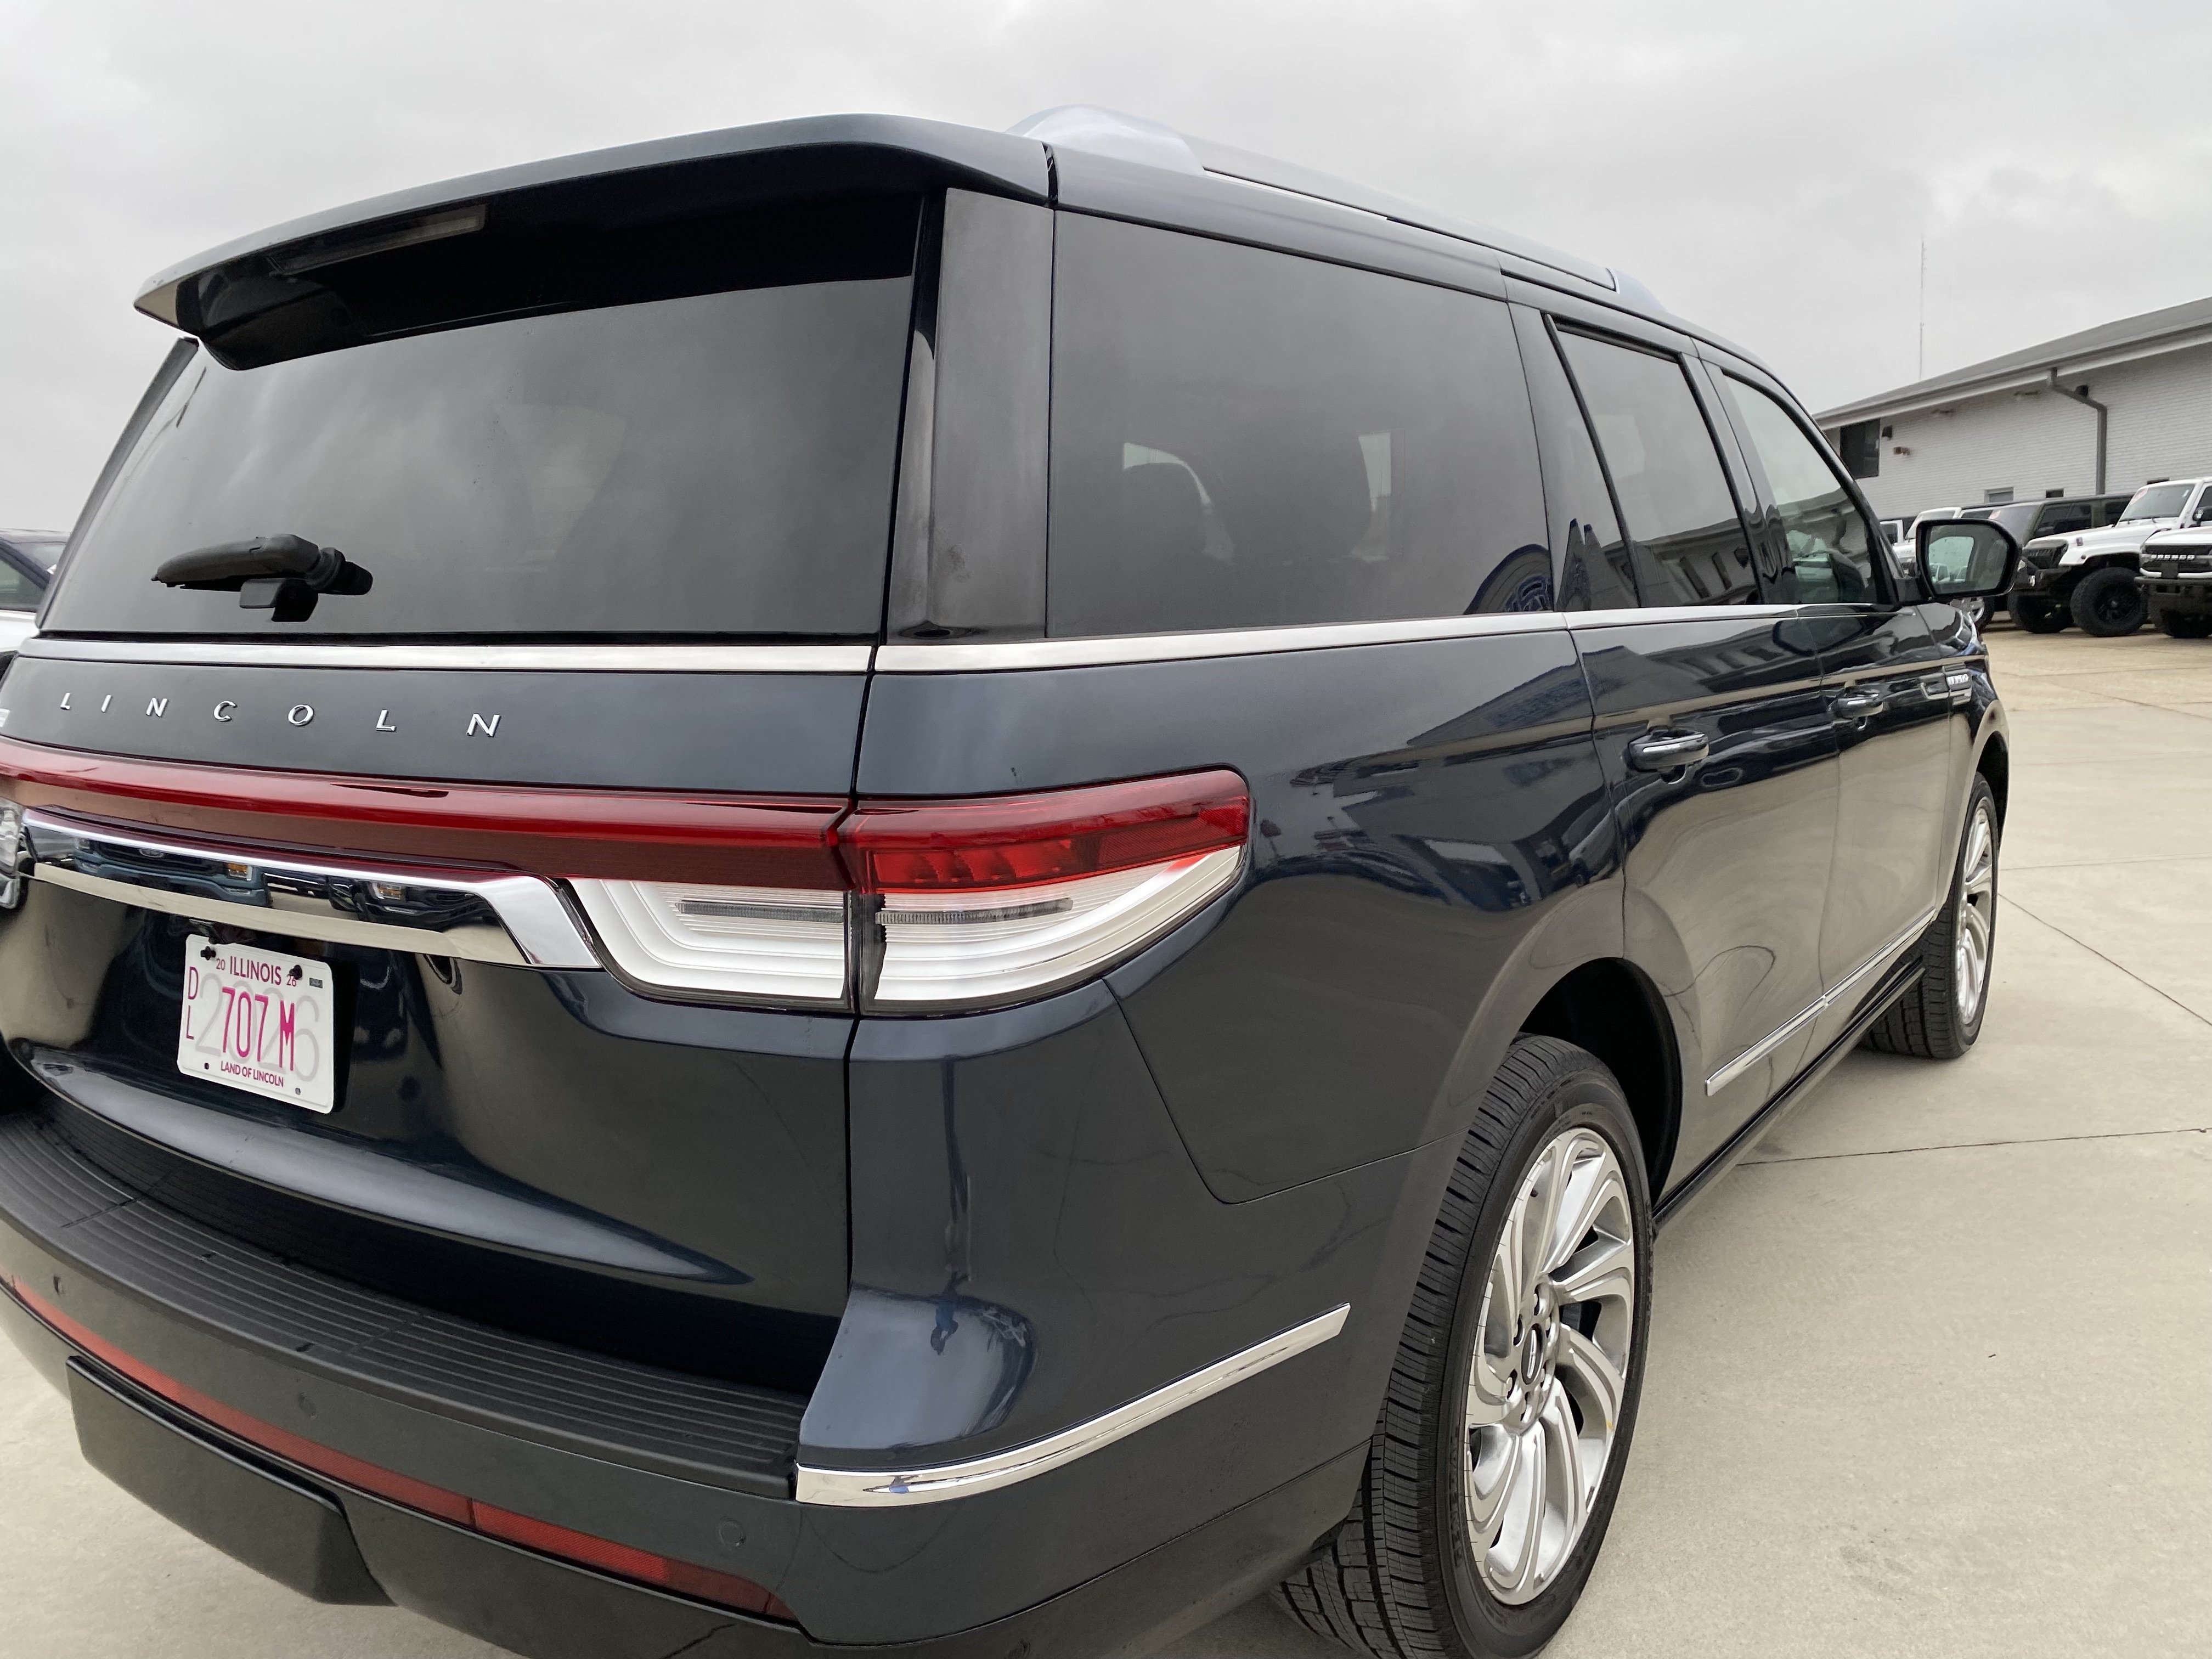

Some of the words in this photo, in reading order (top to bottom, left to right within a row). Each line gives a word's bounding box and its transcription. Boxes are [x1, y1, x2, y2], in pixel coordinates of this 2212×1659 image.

[60, 692, 501, 737] LINCOLN
[216, 958, 225, 970] 20
[230, 956, 281, 985] ILLINOIS
[286, 974, 297, 987] 26
[222, 986, 269, 1062] 707
[279, 1000, 295, 1071] M
[221, 1060, 240, 1075] LAND
[242, 1066, 252, 1077] OF
[253, 1072, 284, 1088] LINCOLN
